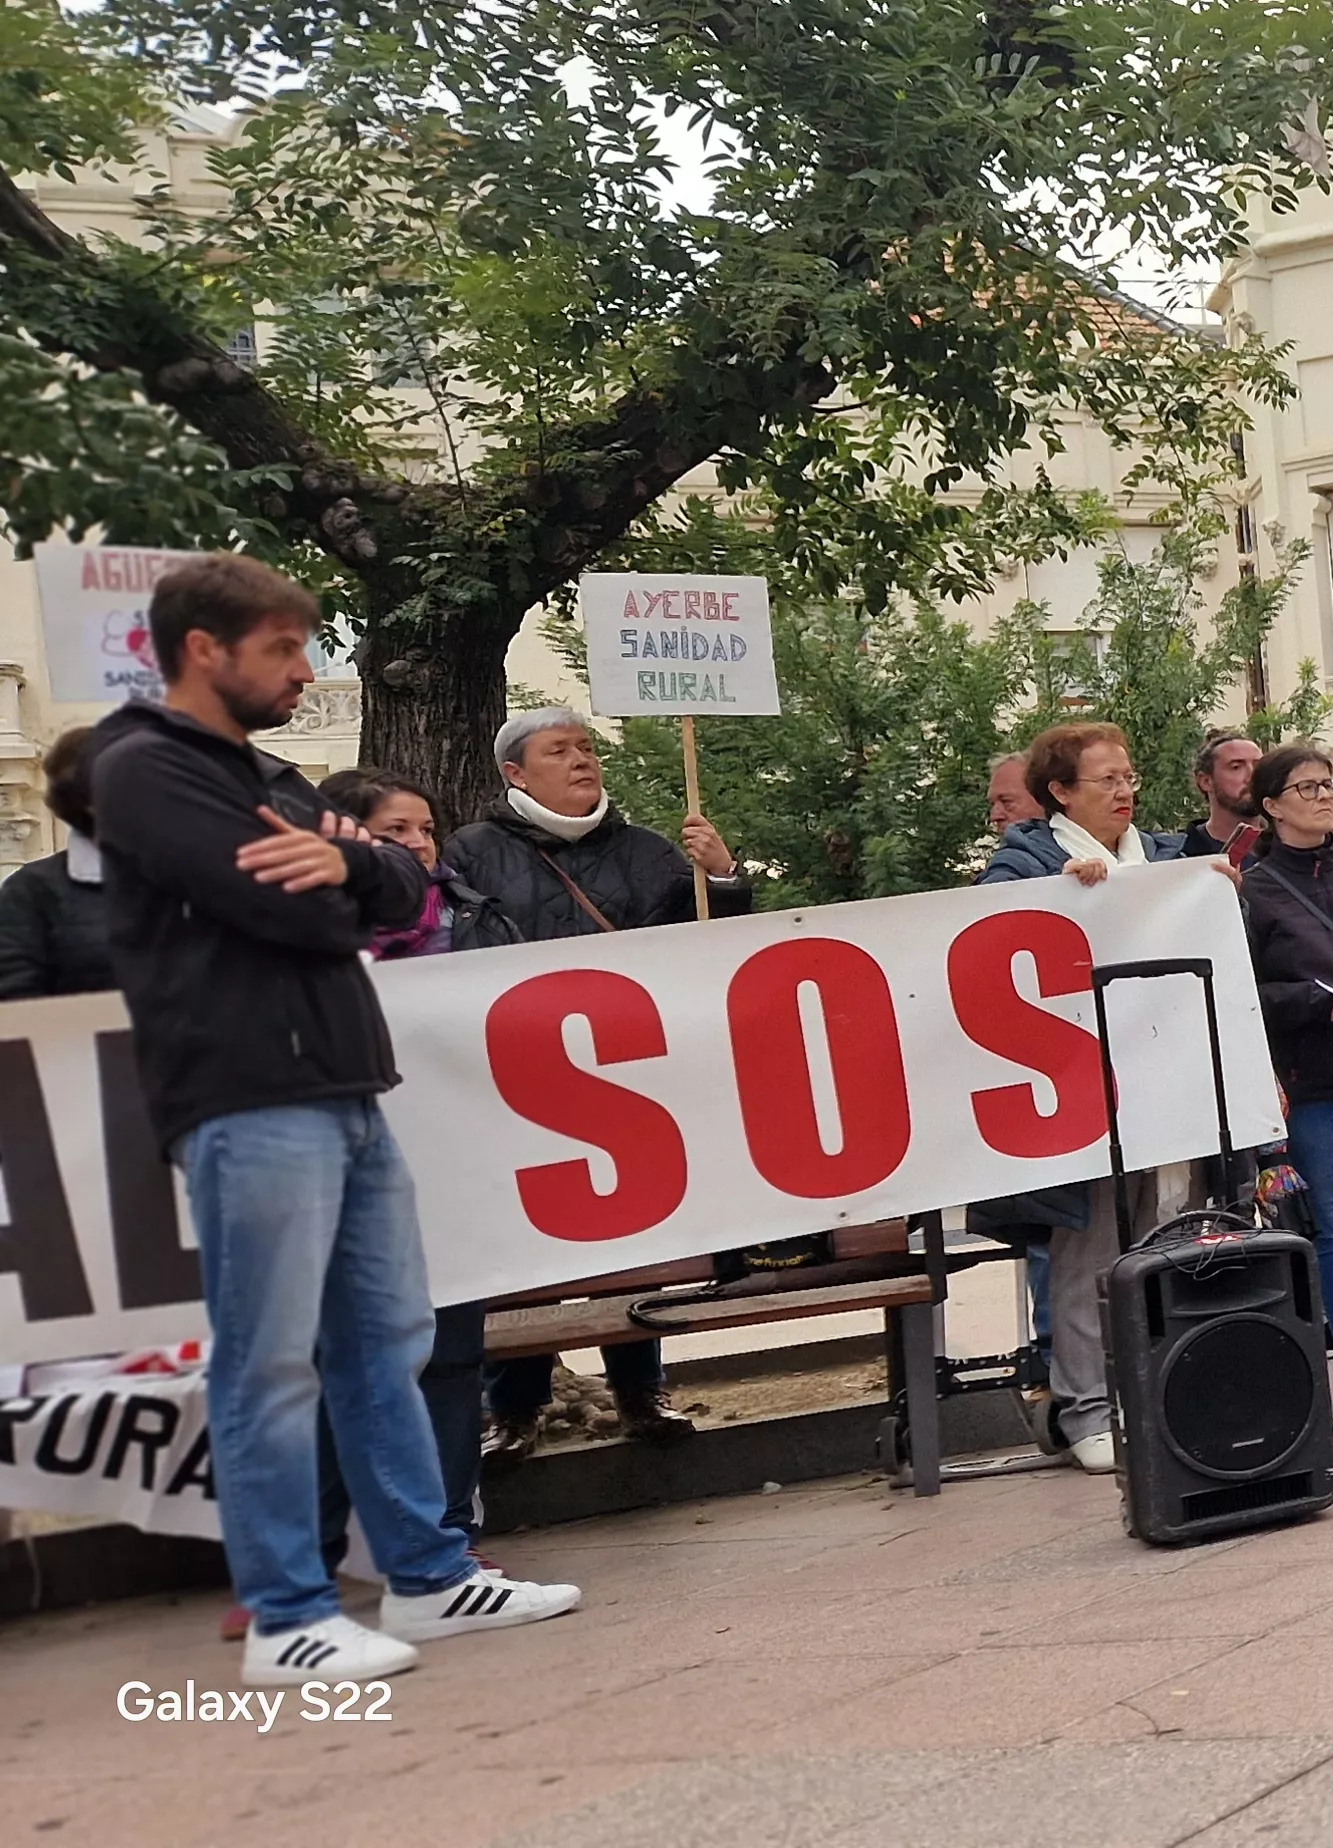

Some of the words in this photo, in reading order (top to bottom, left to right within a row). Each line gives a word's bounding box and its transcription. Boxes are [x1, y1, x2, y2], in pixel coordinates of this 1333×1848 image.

[623, 589, 740, 621] AYERBE
[619, 626, 747, 662] SANIDAD
[637, 670, 736, 703] RURAL
[484, 908, 1119, 1242] SOS
